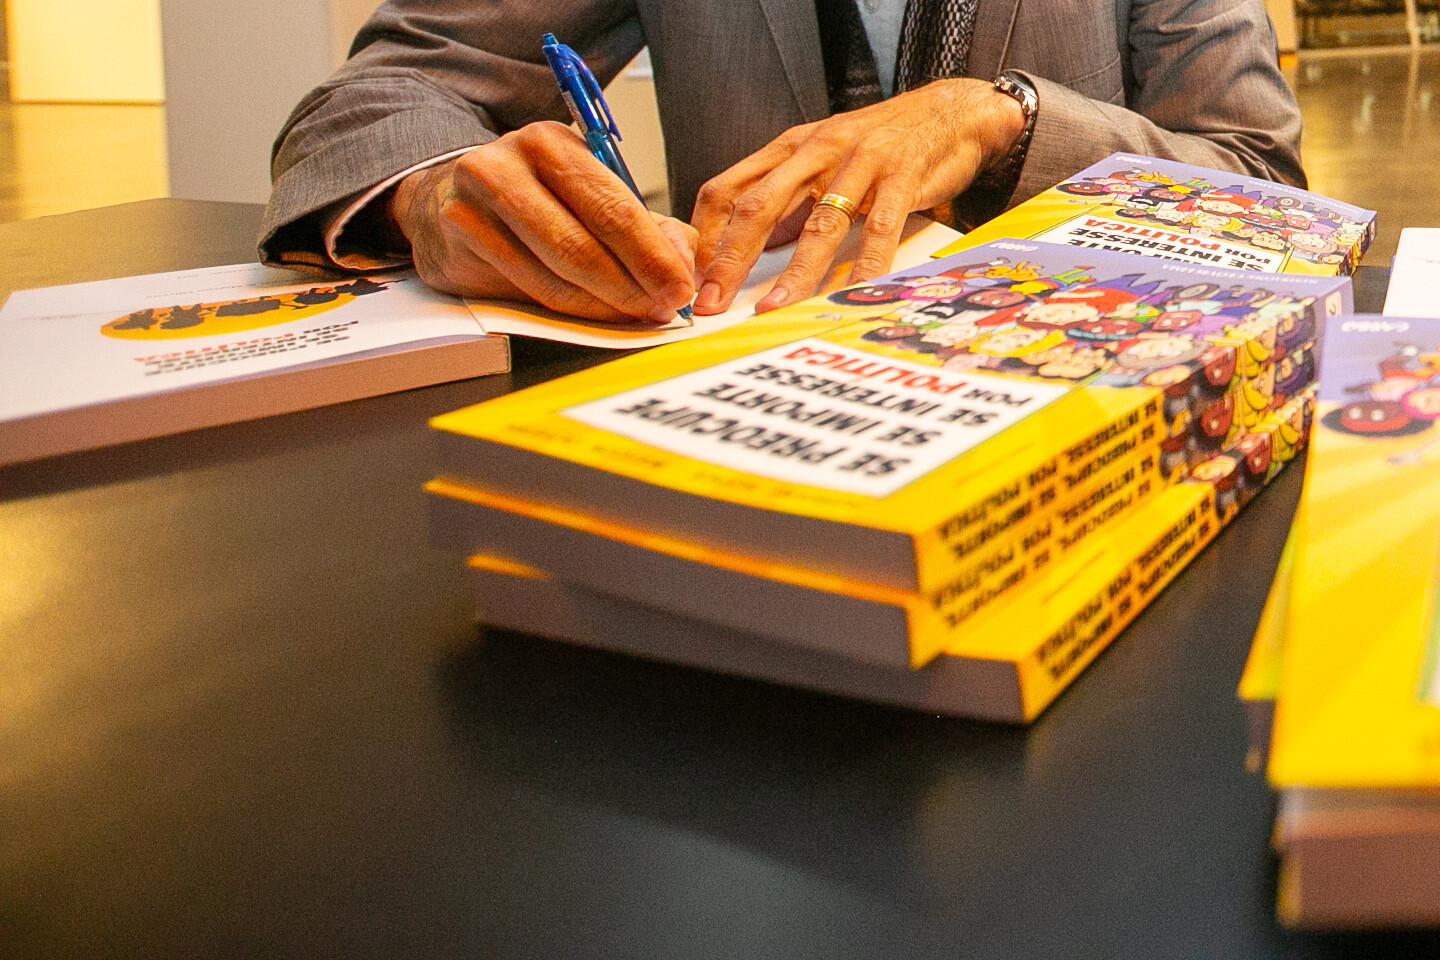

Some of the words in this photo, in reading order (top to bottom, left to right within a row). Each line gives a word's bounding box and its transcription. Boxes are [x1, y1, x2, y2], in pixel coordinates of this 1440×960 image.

[1068, 228, 1223, 262] INTERESSE
[1084, 218, 1222, 251] POLÍTICA
[1225, 248, 1270, 265] POR
[1225, 260, 1263, 272] SE
[783, 346, 967, 396] POLÍTICA
[732, 362, 941, 418] INTERESSE
[963, 389, 1032, 408] POR
[691, 383, 881, 437] IMPORTE
[939, 408, 998, 429] SE
[610, 398, 841, 466] PREOCUPE
[884, 425, 942, 449] SE
[846, 453, 910, 480] SE
